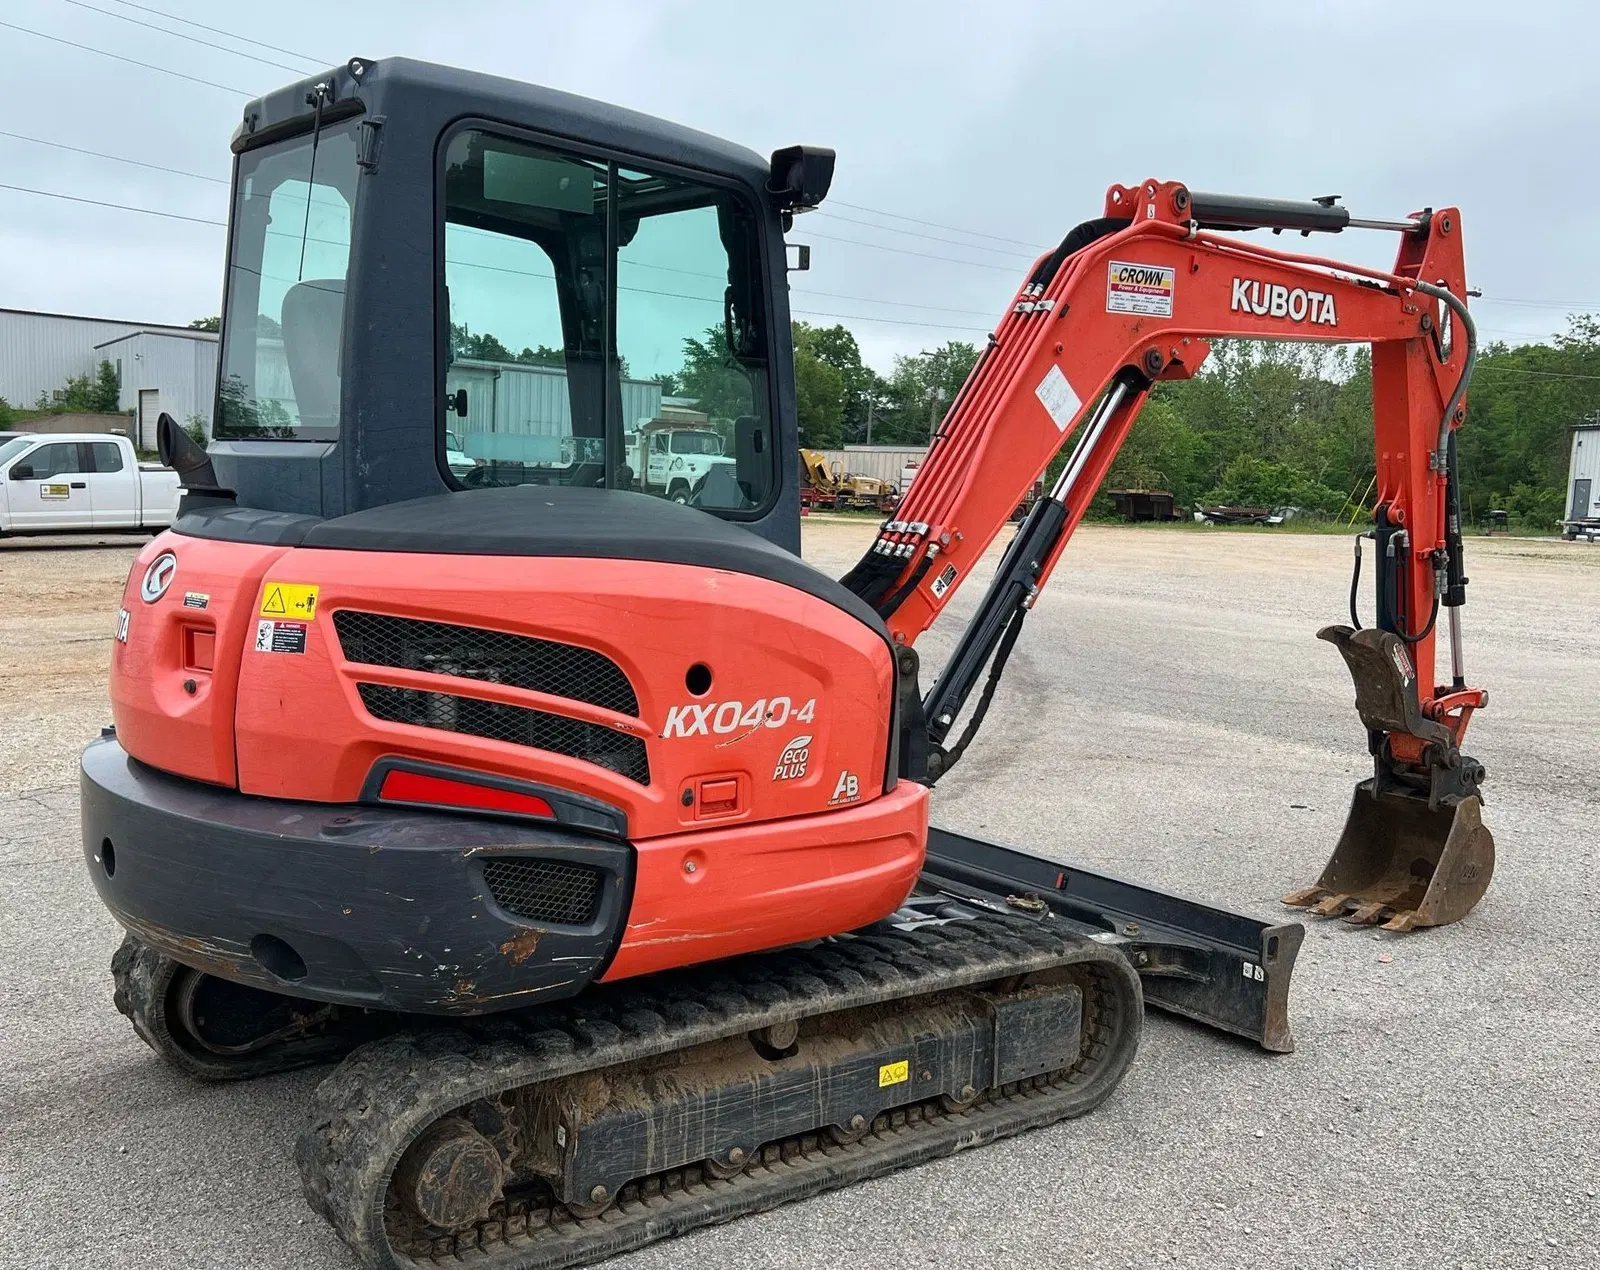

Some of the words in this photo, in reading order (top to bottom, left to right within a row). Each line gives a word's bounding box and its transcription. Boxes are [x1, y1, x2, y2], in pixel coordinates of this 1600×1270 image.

[1119, 267, 1164, 286] CROWN
[1139, 286, 1165, 295] Equipment
[1231, 277, 1337, 326] KUBOTA
[662, 697, 816, 738] KX040-4
[783, 748, 809, 764] eco
[772, 762, 807, 780] PLUS
[831, 770, 859, 800] AB
